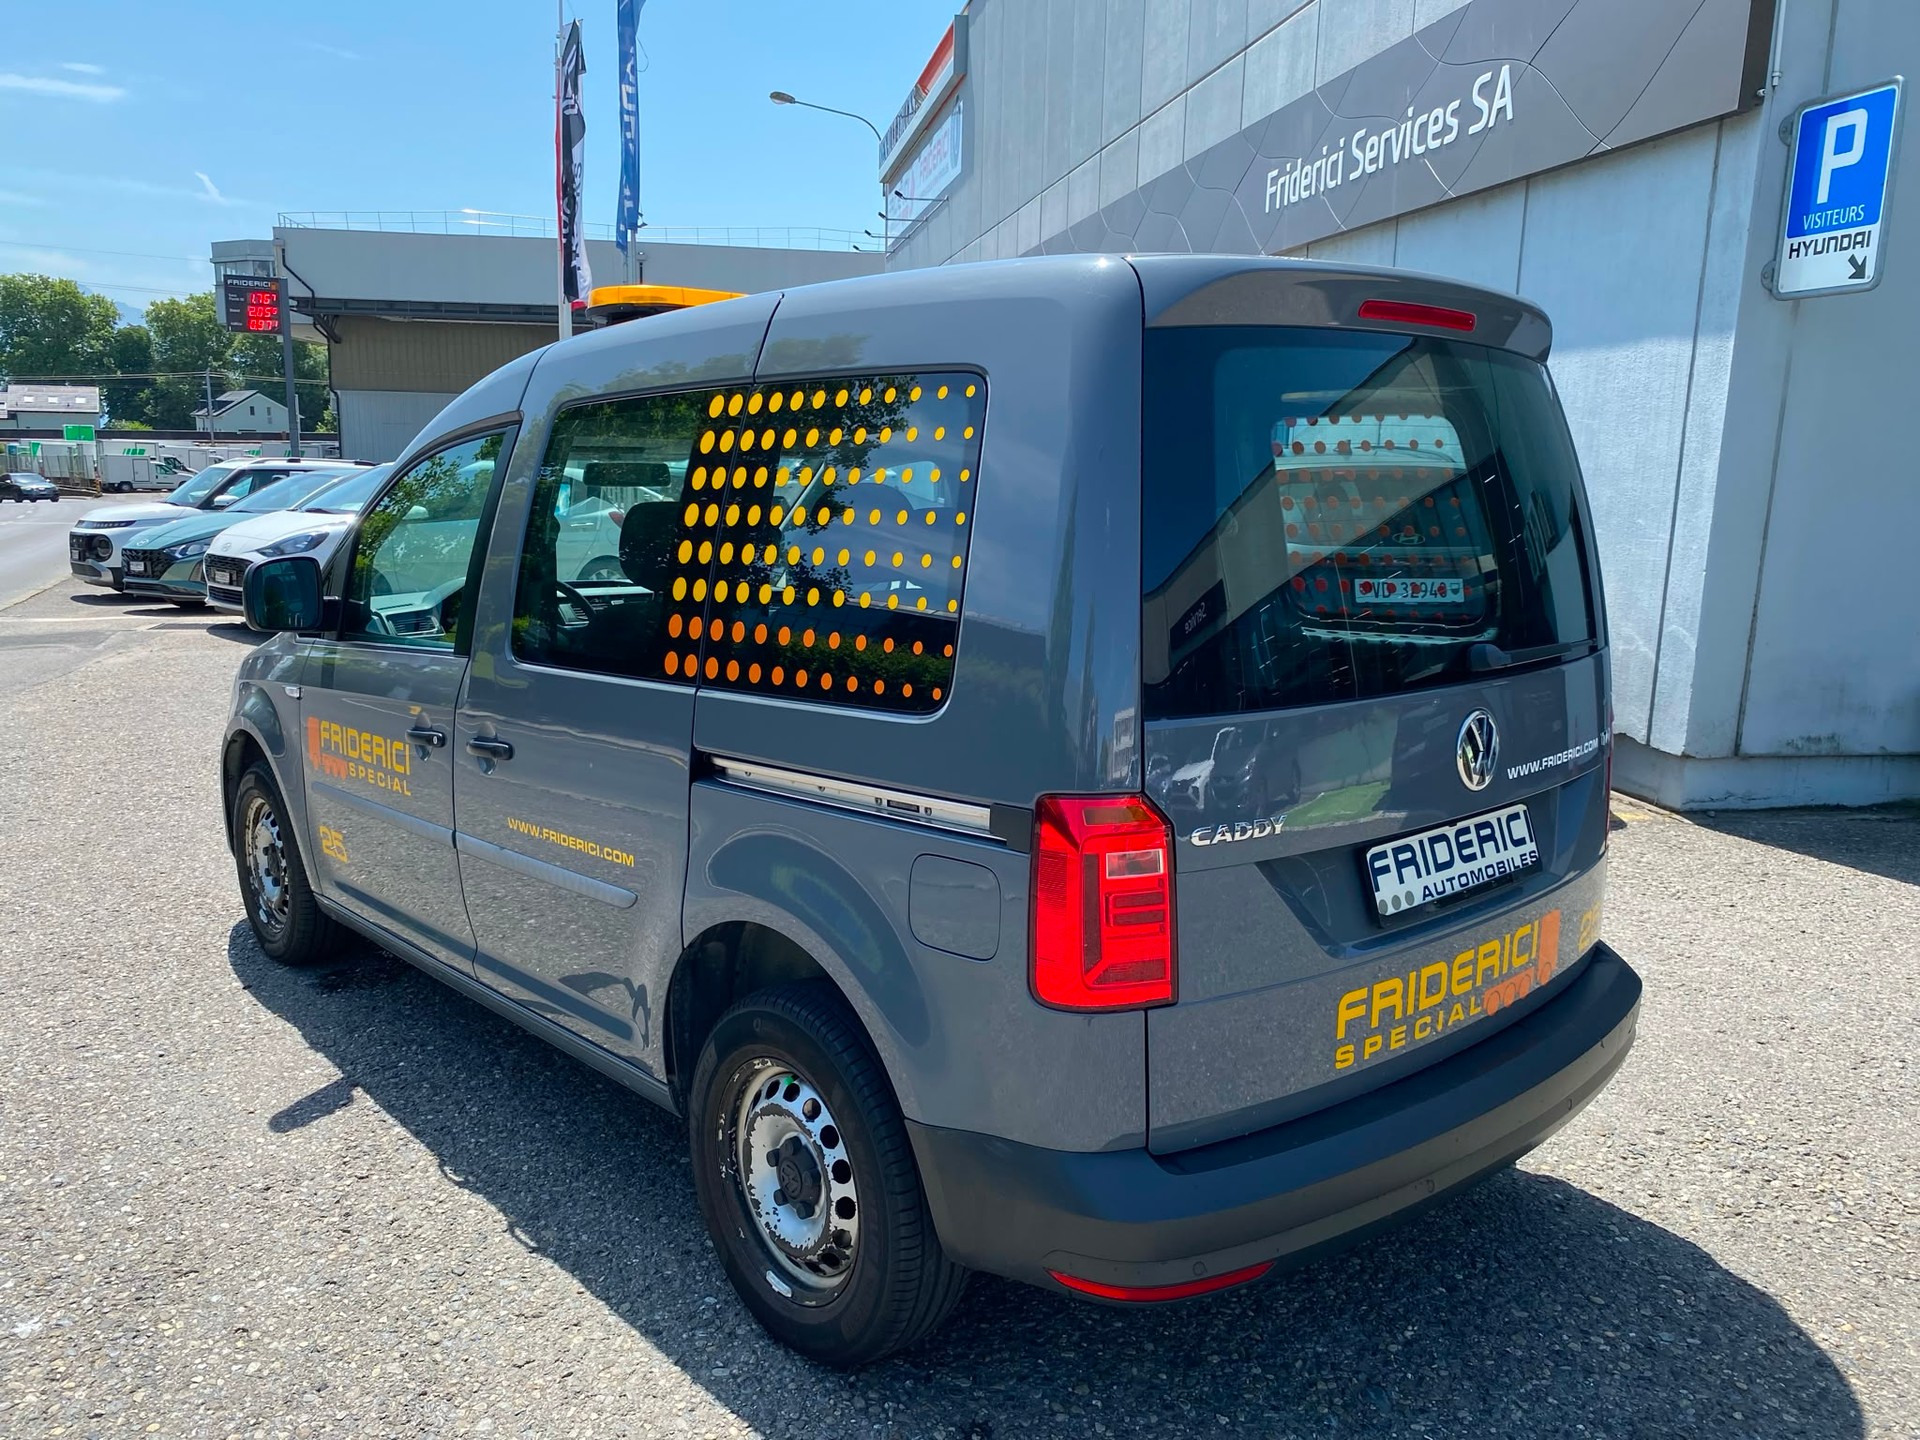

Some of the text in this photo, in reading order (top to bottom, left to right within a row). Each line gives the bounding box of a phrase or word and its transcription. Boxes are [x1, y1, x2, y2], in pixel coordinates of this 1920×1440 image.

[1265, 64, 1514, 214] Friderici Services SA
[1816, 108, 1868, 205] P
[1803, 204, 1865, 230] VISITEURS
[1788, 230, 1872, 260] HYUNDAI
[227, 279, 270, 287] FRIDERICI
[320, 720, 411, 776] FRIDERICI
[1507, 738, 1599, 780] WWW.FRIDERICI.COM
[349, 762, 411, 796] SPECIAL
[507, 816, 635, 868] WWW.FRIDERICI.COM
[1191, 815, 1288, 847] CADDY
[1369, 810, 1534, 893] FRIDERICI
[1422, 850, 1539, 901] AUTOMOBILES
[1336, 919, 1540, 1040] FRIDERICI
[1334, 996, 1482, 1070] SPECIAL
